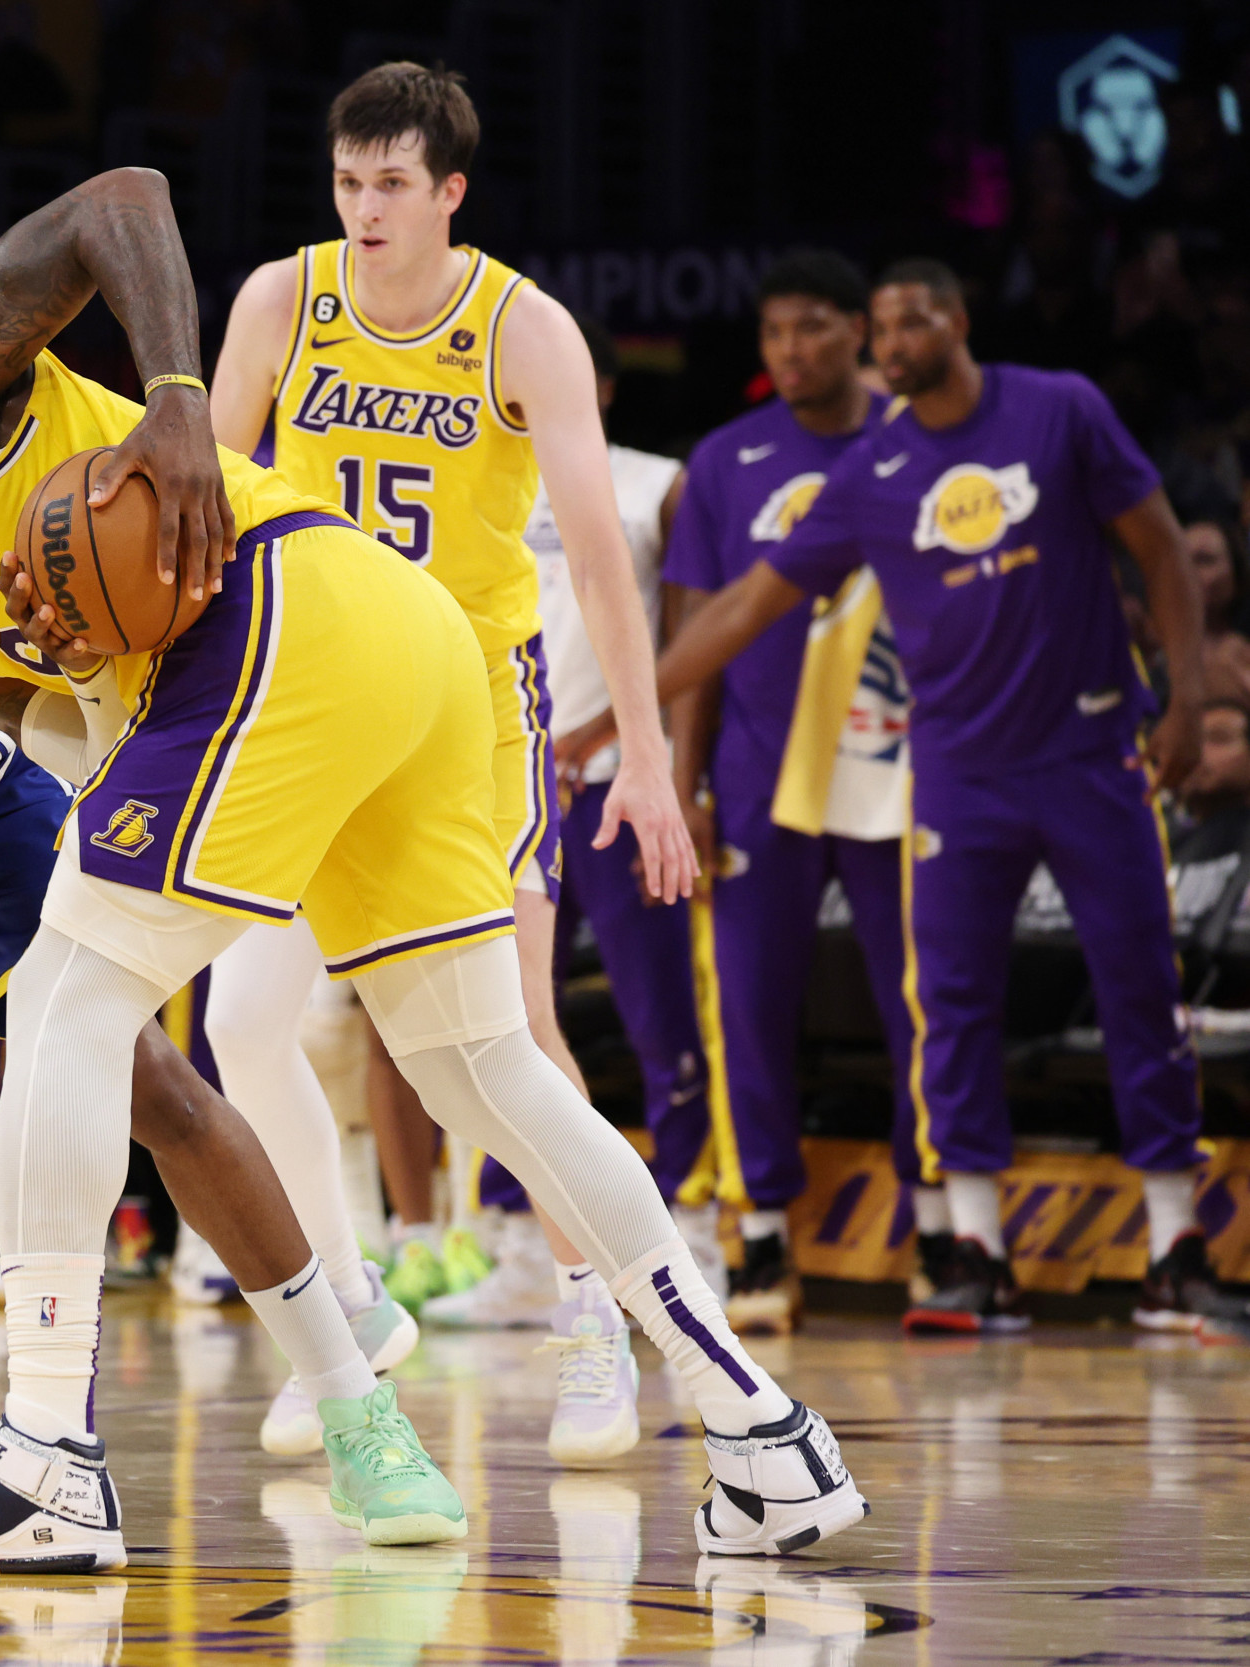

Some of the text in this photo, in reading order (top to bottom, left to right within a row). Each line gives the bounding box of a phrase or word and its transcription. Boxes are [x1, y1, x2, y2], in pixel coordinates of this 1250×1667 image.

[316, 296, 335, 321] 6
[437, 353, 482, 371] bibigo
[291, 363, 481, 450] LAKERS
[336, 455, 434, 568] 15
[41, 492, 90, 633] Wilson
